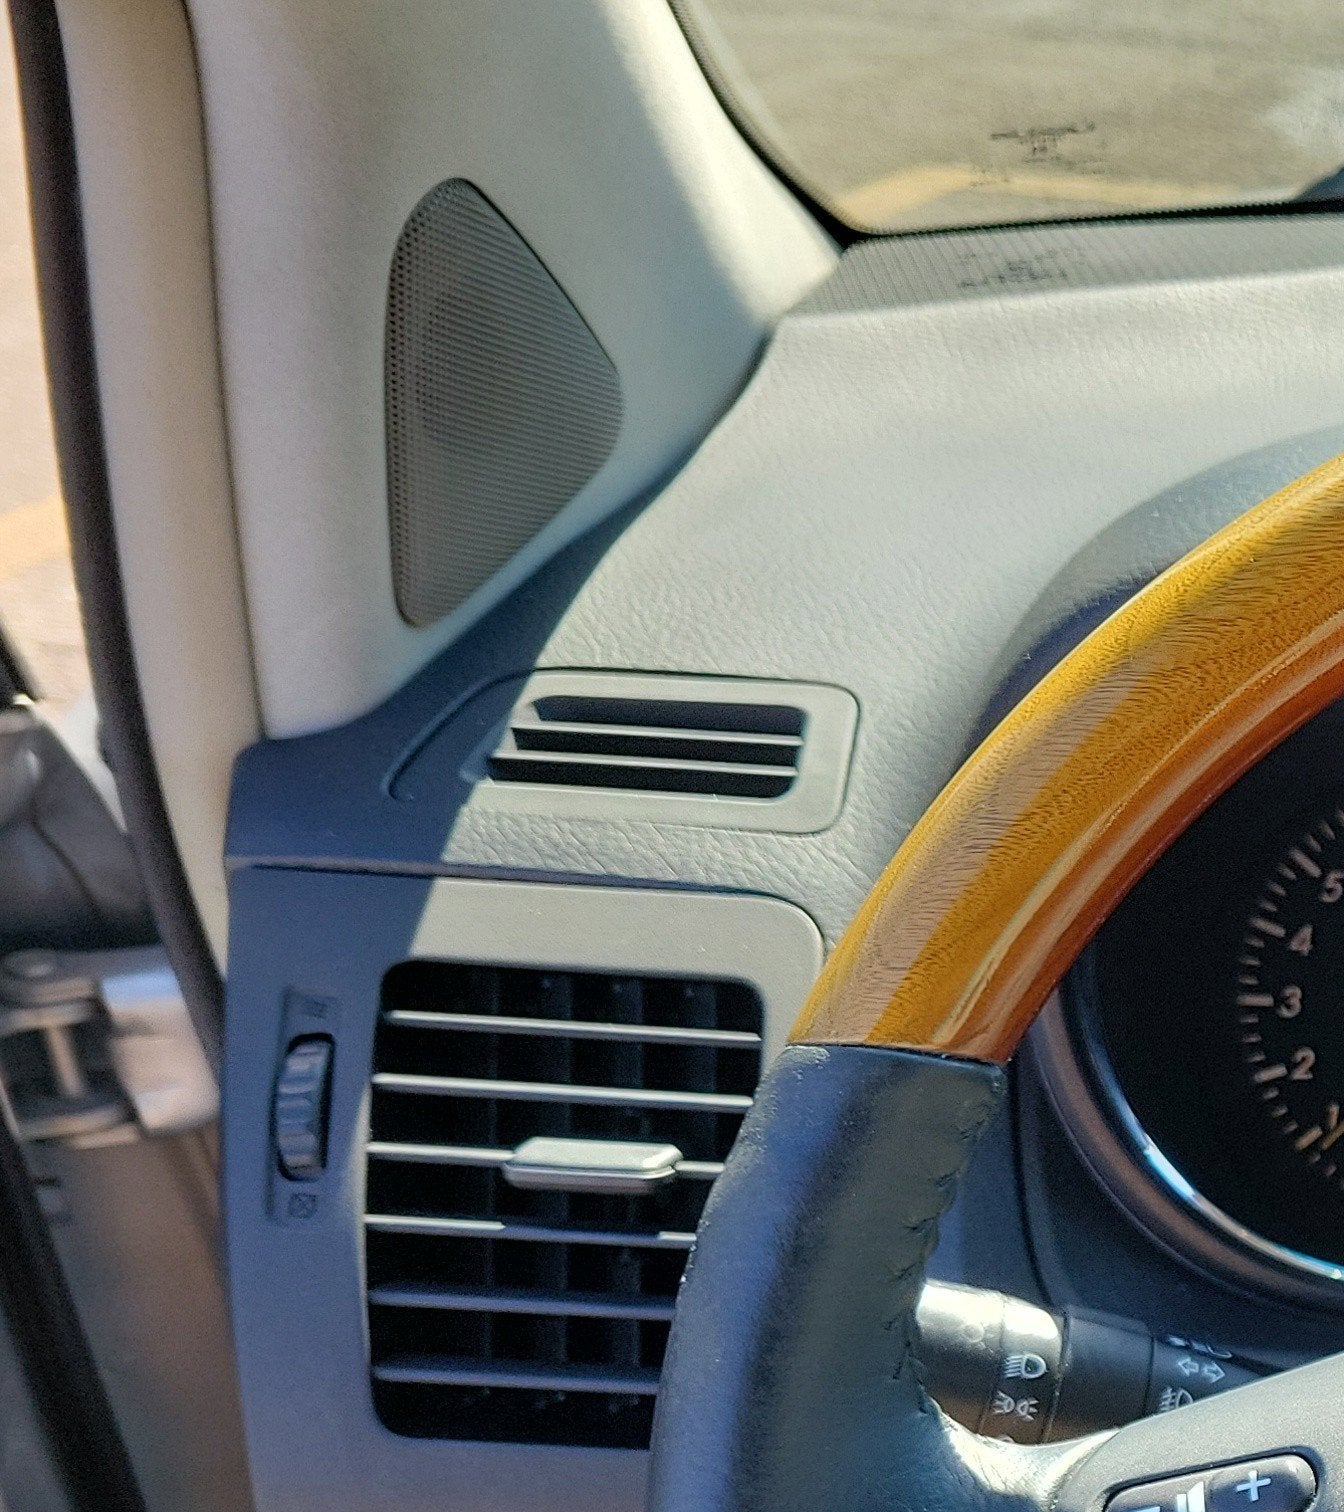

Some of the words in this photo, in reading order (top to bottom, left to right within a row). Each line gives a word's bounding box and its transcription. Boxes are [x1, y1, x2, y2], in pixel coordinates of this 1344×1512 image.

[1289, 923, 1314, 956] 4
[1276, 985, 1302, 1019] 3
[1291, 1046, 1316, 1081] 2
[1326, 1102, 1342, 1128] 1
